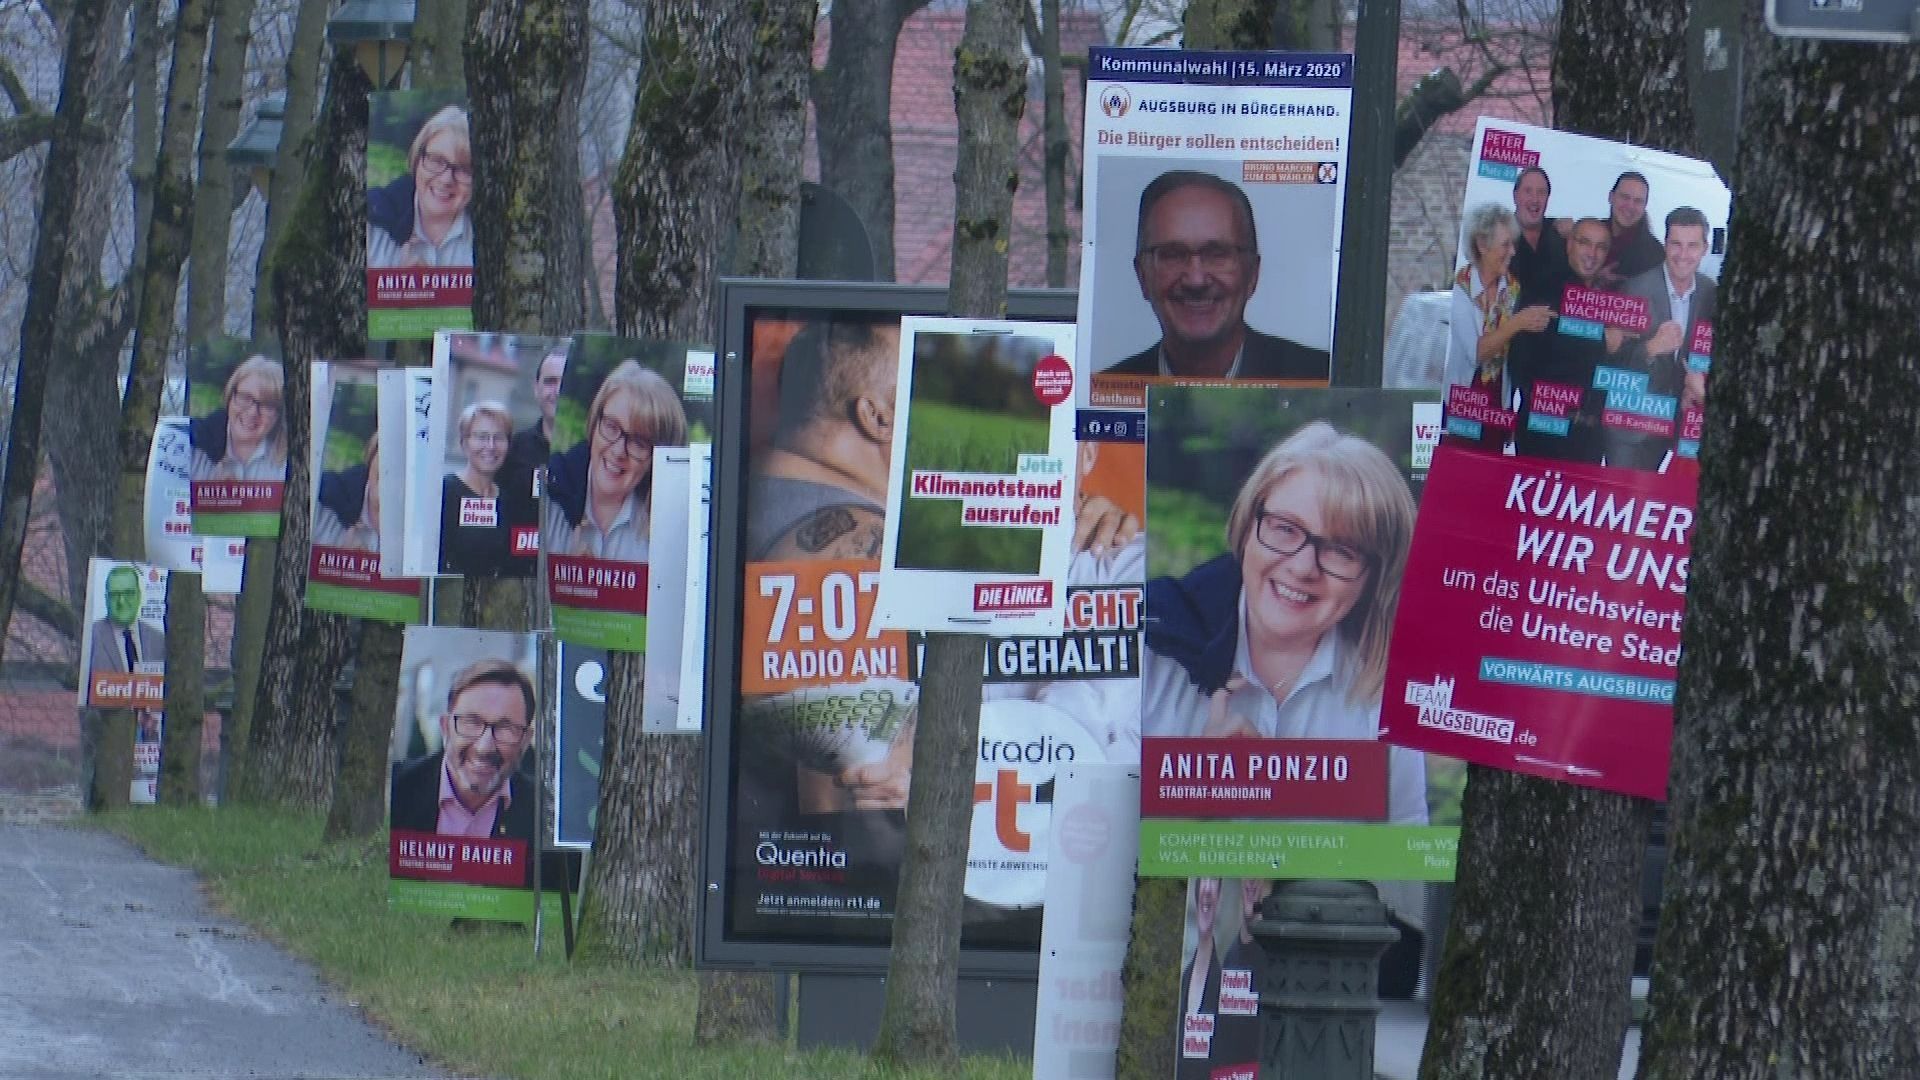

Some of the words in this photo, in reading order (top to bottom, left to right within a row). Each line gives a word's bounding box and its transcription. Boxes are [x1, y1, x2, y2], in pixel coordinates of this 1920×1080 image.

[1101, 55, 1227, 76] Kommunalwahl
[1264, 60, 1302, 77] März
[1306, 62, 1342, 78] 2020
[1139, 99, 1216, 115] AUGSBURG
[1222, 102, 1236, 115] IN
[1241, 100, 1340, 117] BÜRGERHAND.
[1098, 129, 1123, 146] Die
[1127, 131, 1181, 150] Bürger
[1185, 134, 1235, 150] sollen
[1240, 135, 1340, 153] entscheiden!
[1486, 131, 1523, 148] PETER
[1484, 147, 1538, 166] HAMMER
[377, 274, 416, 290] ANITA
[422, 273, 473, 289] PONZIO
[1566, 289, 1644, 313] CHRISTOPH
[1565, 303, 1648, 329] WACHINGER
[1595, 369, 1640, 393] DIRK
[1091, 391, 1142, 406] Gasthaus
[1451, 387, 1489, 407] INGRID
[1535, 384, 1580, 404] KENAN
[1607, 391, 1671, 417] WURM
[1449, 401, 1515, 427] SCHALETZKY
[1533, 399, 1566, 415] INAN
[1605, 413, 1669, 434] OB-Kandidat
[1020, 456, 1063, 474] Jetzt
[197, 485, 228, 498] ANITA
[231, 486, 273, 499] PONZIO
[914, 474, 1063, 500] Klimanotstand
[964, 504, 1060, 526] ausrufen!
[1504, 469, 1693, 545] KÜMMER
[1516, 523, 1594, 574] WIR
[318, 551, 355, 571] ANITA
[554, 563, 584, 585] ANITA
[587, 566, 637, 590] PONZIO
[978, 588, 1003, 607] DIE
[1443, 567, 1476, 591] um
[1482, 569, 1520, 600] das
[1528, 577, 1682, 634] Ulrichsviert
[1479, 604, 1514, 633] die
[1521, 611, 1613, 654] Untere
[763, 648, 843, 680] RADIO
[851, 646, 898, 677] AN!
[998, 634, 1130, 676] GEHALT!
[95, 679, 132, 699] Gerd
[1483, 659, 1573, 688] VORWÄRTS
[1577, 674, 1674, 701] AUGSBURG
[1408, 684, 1449, 709] TEAM
[1158, 752, 1236, 780] ANITA
[1249, 753, 1349, 782] PONZIO
[399, 839, 456, 861] HELMUT
[461, 845, 513, 865] BAUER
[1158, 832, 1245, 848] KOMPETENZ
[1250, 833, 1282, 849] UND
[755, 841, 847, 868] Quentia
[758, 893, 785, 906] Jetzt
